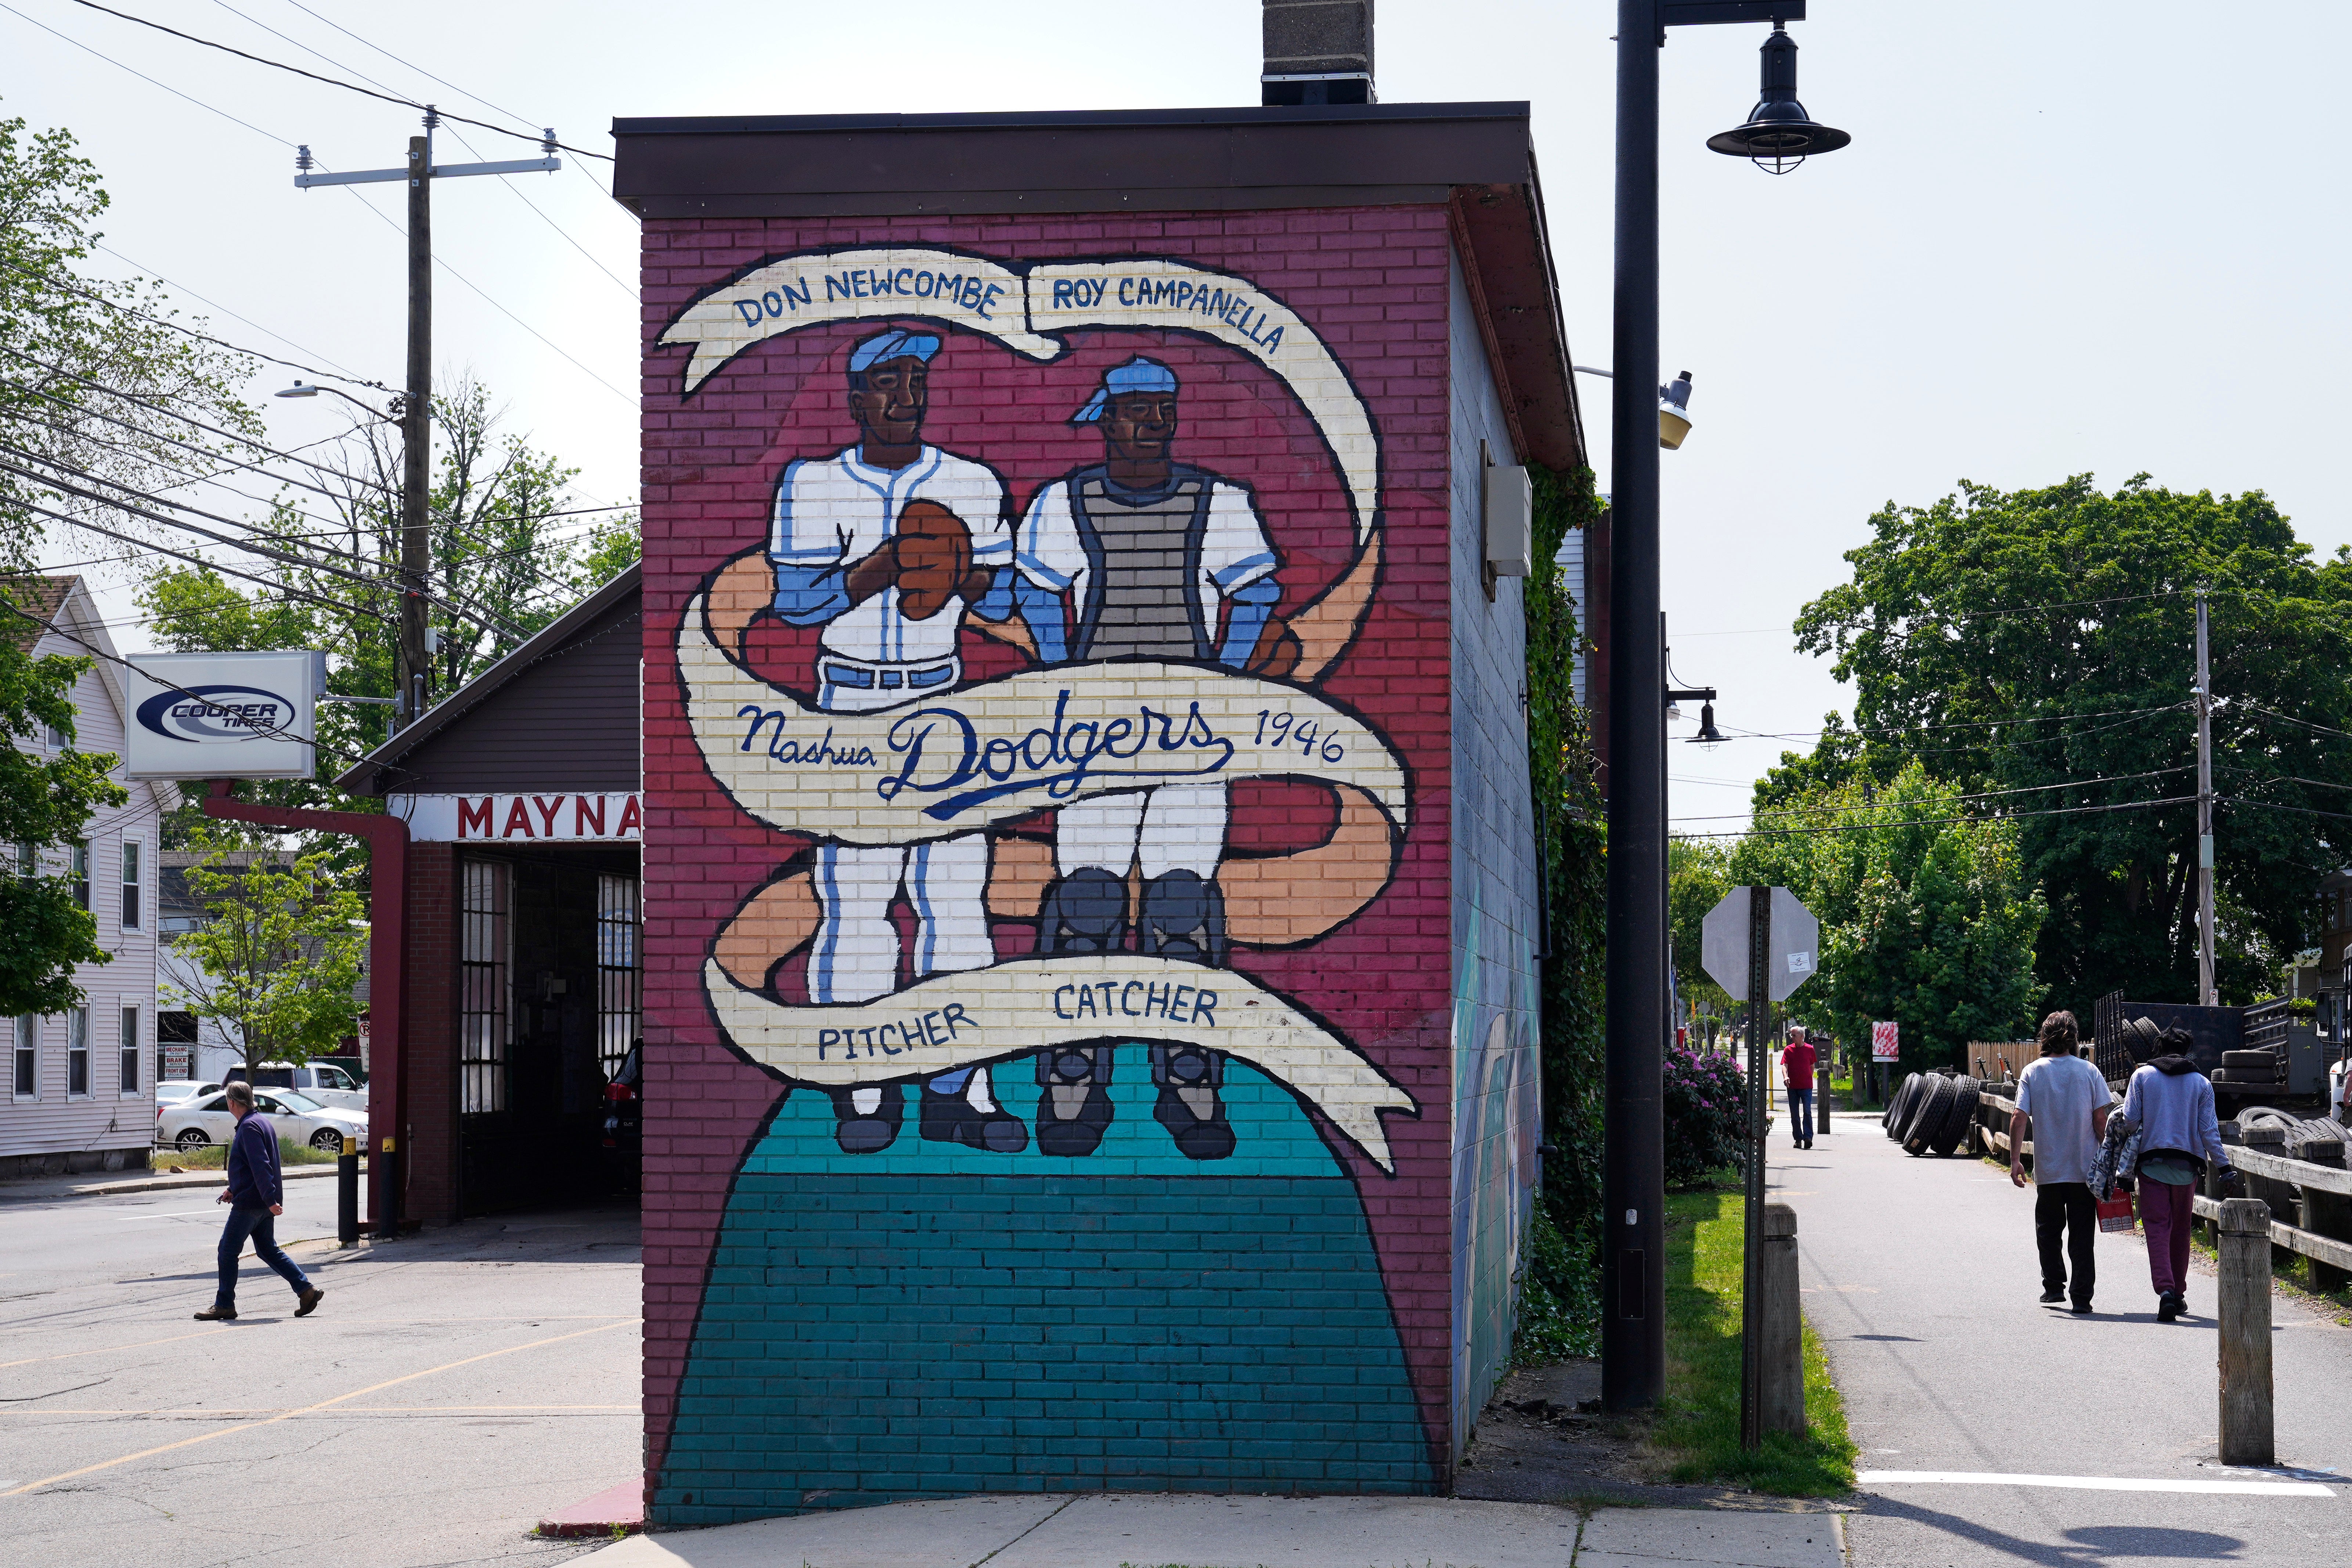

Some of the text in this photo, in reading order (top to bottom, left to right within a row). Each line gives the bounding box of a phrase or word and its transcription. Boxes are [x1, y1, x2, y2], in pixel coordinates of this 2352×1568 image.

[733, 268, 1005, 328] DON NEWCOMBE
[1054, 278, 1284, 355] ROY CAMPANELLA
[171, 704, 278, 718] COOPER
[222, 718, 275, 727] TIRES
[737, 690, 1343, 821] Nashua Dodgers 1946
[819, 1003, 978, 1060] PITCHER
[1055, 981, 1217, 1027] CATCHER
